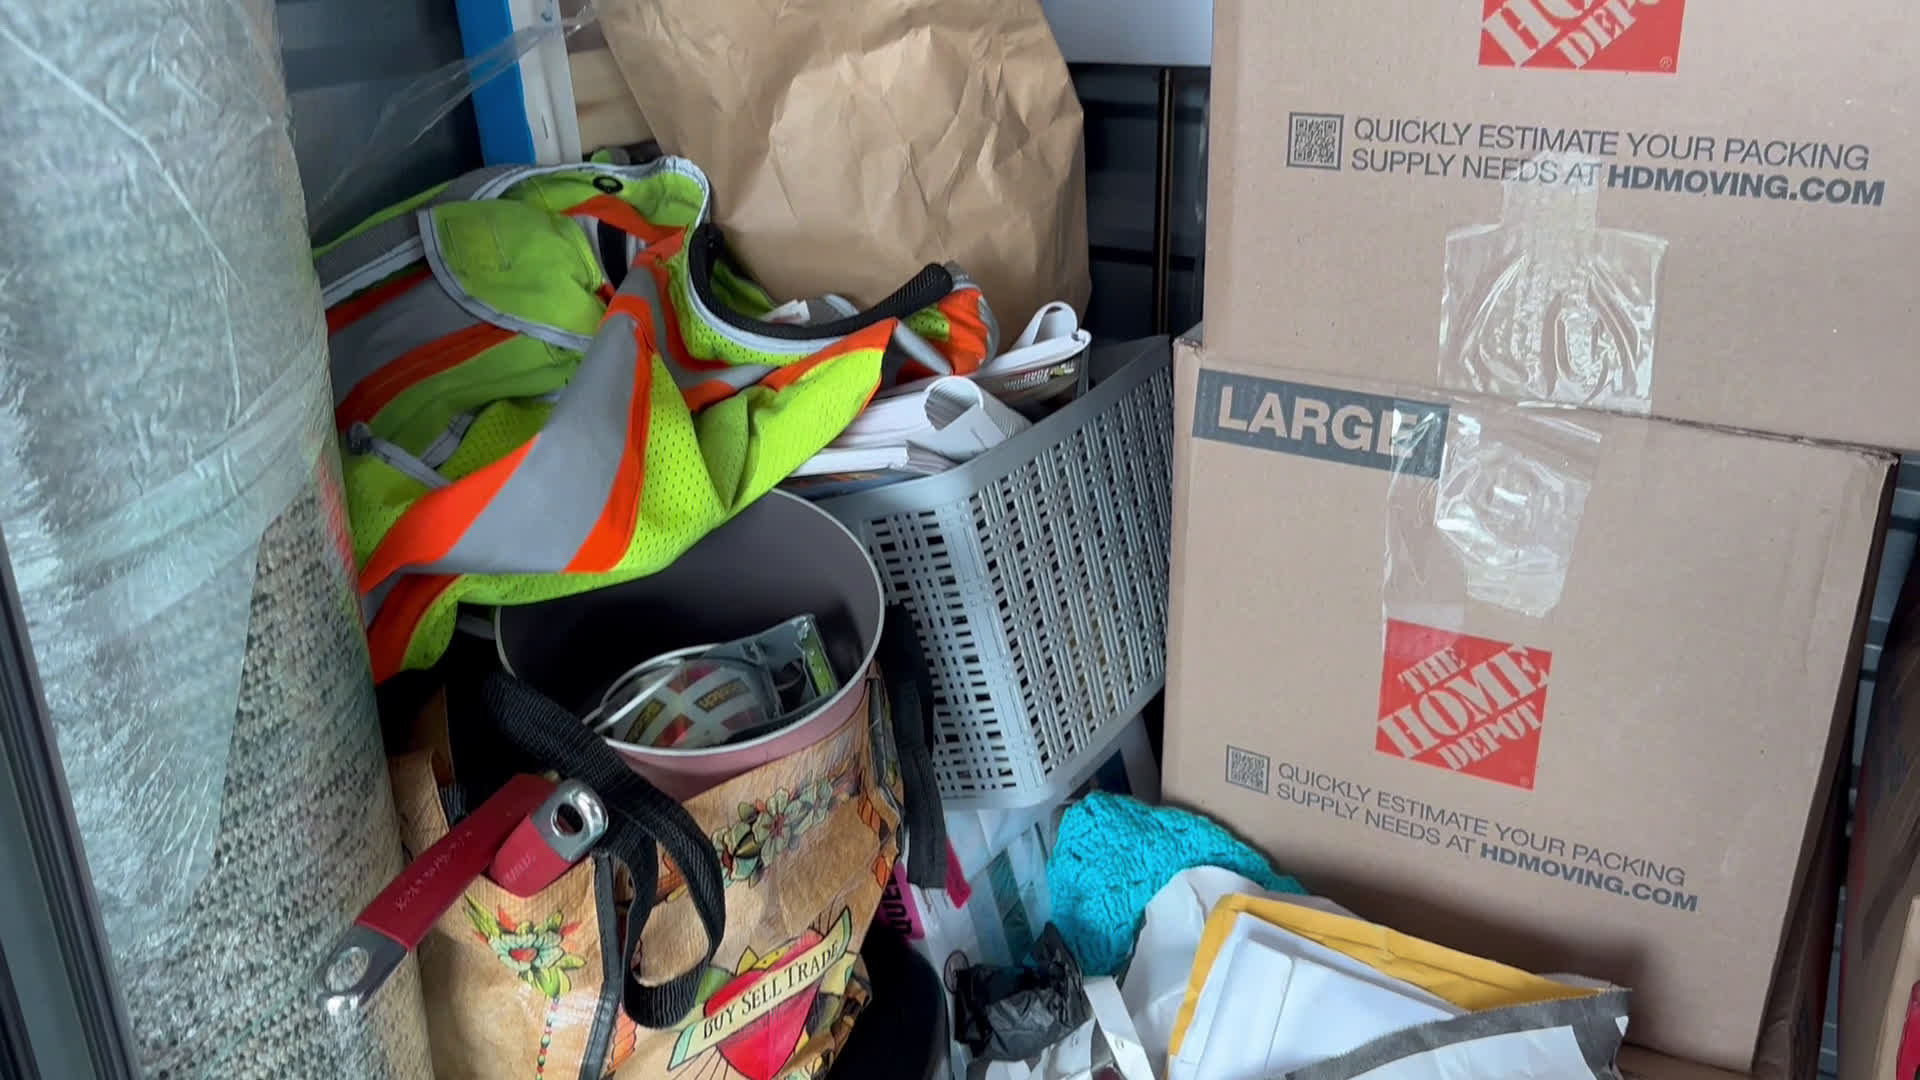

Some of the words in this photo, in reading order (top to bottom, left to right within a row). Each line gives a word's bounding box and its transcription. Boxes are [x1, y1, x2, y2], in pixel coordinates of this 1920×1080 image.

[1351, 147, 1456, 177] SUPPLY
[1462, 156, 1559, 185] NEEDS
[1563, 161, 1603, 186] AT
[1606, 164, 1886, 206] HDMOVING.COM
[1354, 117, 1472, 146] QUICKLY
[1478, 124, 1619, 157] ESTIMATE
[1626, 131, 1715, 162] YOUR
[1723, 137, 1870, 172] PACKING
[1217, 385, 1417, 459] LARGE
[1378, 640, 1550, 759] HOME
[1397, 646, 1467, 695] THE
[1437, 700, 1542, 771] DEPOT
[1277, 783, 1360, 821] SUPPLY
[1364, 808, 1441, 846] NEEDS
[1446, 833, 1476, 854] AT
[1480, 842, 1698, 912] HDMOVING.COM
[1278, 763, 1372, 802] QUICKLY
[1377, 791, 1489, 837] ESTIMATE
[1495, 822, 1566, 857] YOUR
[1572, 843, 1686, 887] PACKING
[702, 1004, 737, 1040] BUY
[741, 974, 783, 1016] SELL
[784, 940, 839, 988] TRADE
